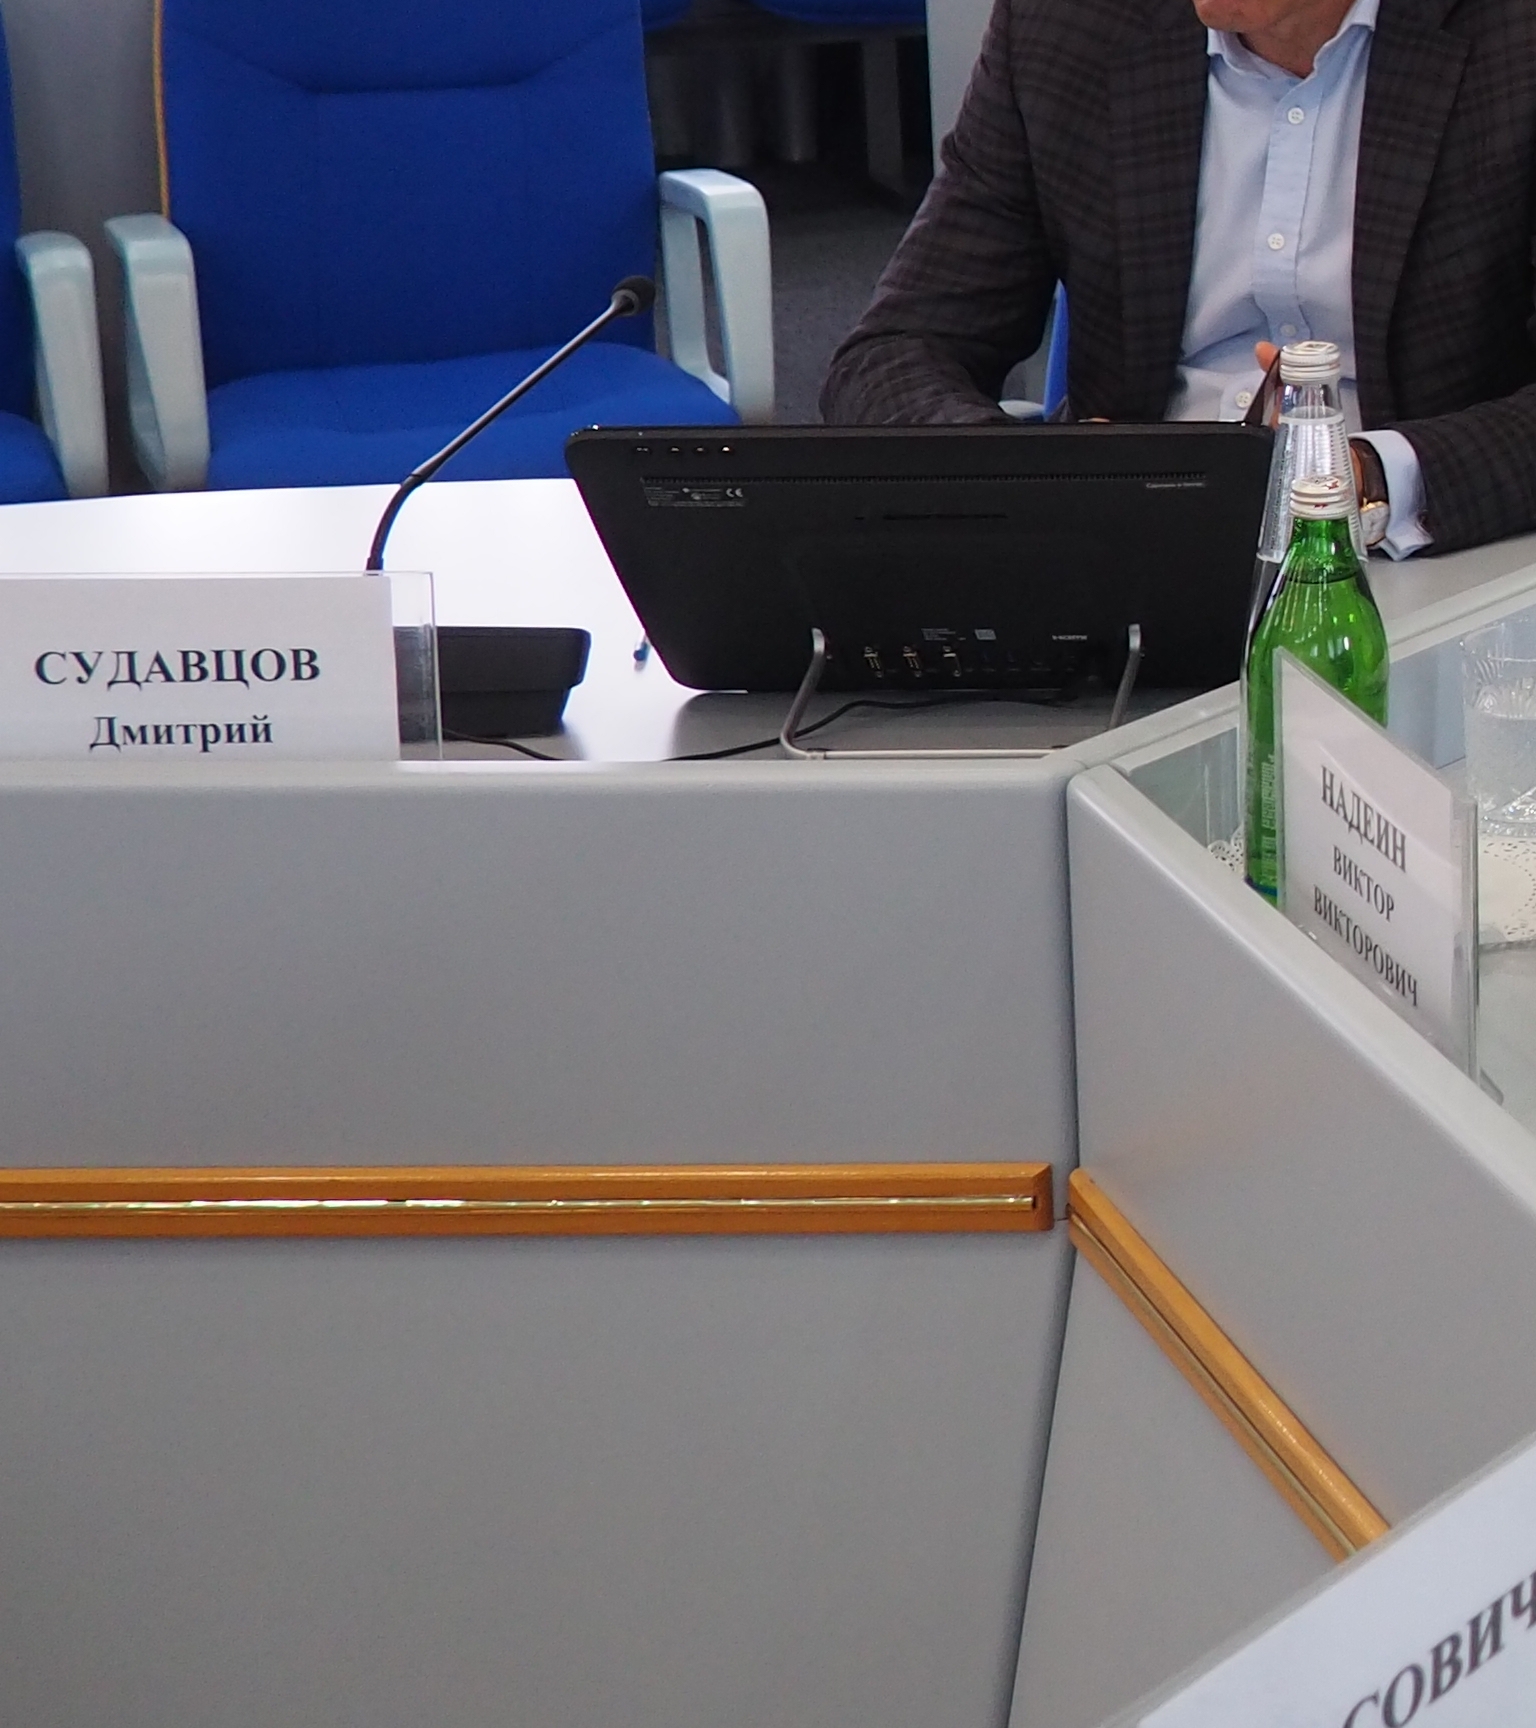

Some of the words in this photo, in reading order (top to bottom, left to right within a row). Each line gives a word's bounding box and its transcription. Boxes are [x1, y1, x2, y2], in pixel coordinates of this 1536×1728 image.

[34, 647, 321, 691] СУДАВЦОВ
[88, 714, 273, 753] Дмитрий
[1321, 765, 1407, 873] НАДЕИН
[1333, 844, 1395, 922] ВИКТОР
[1313, 883, 1418, 1007] ВИКТОРОВИЧ
